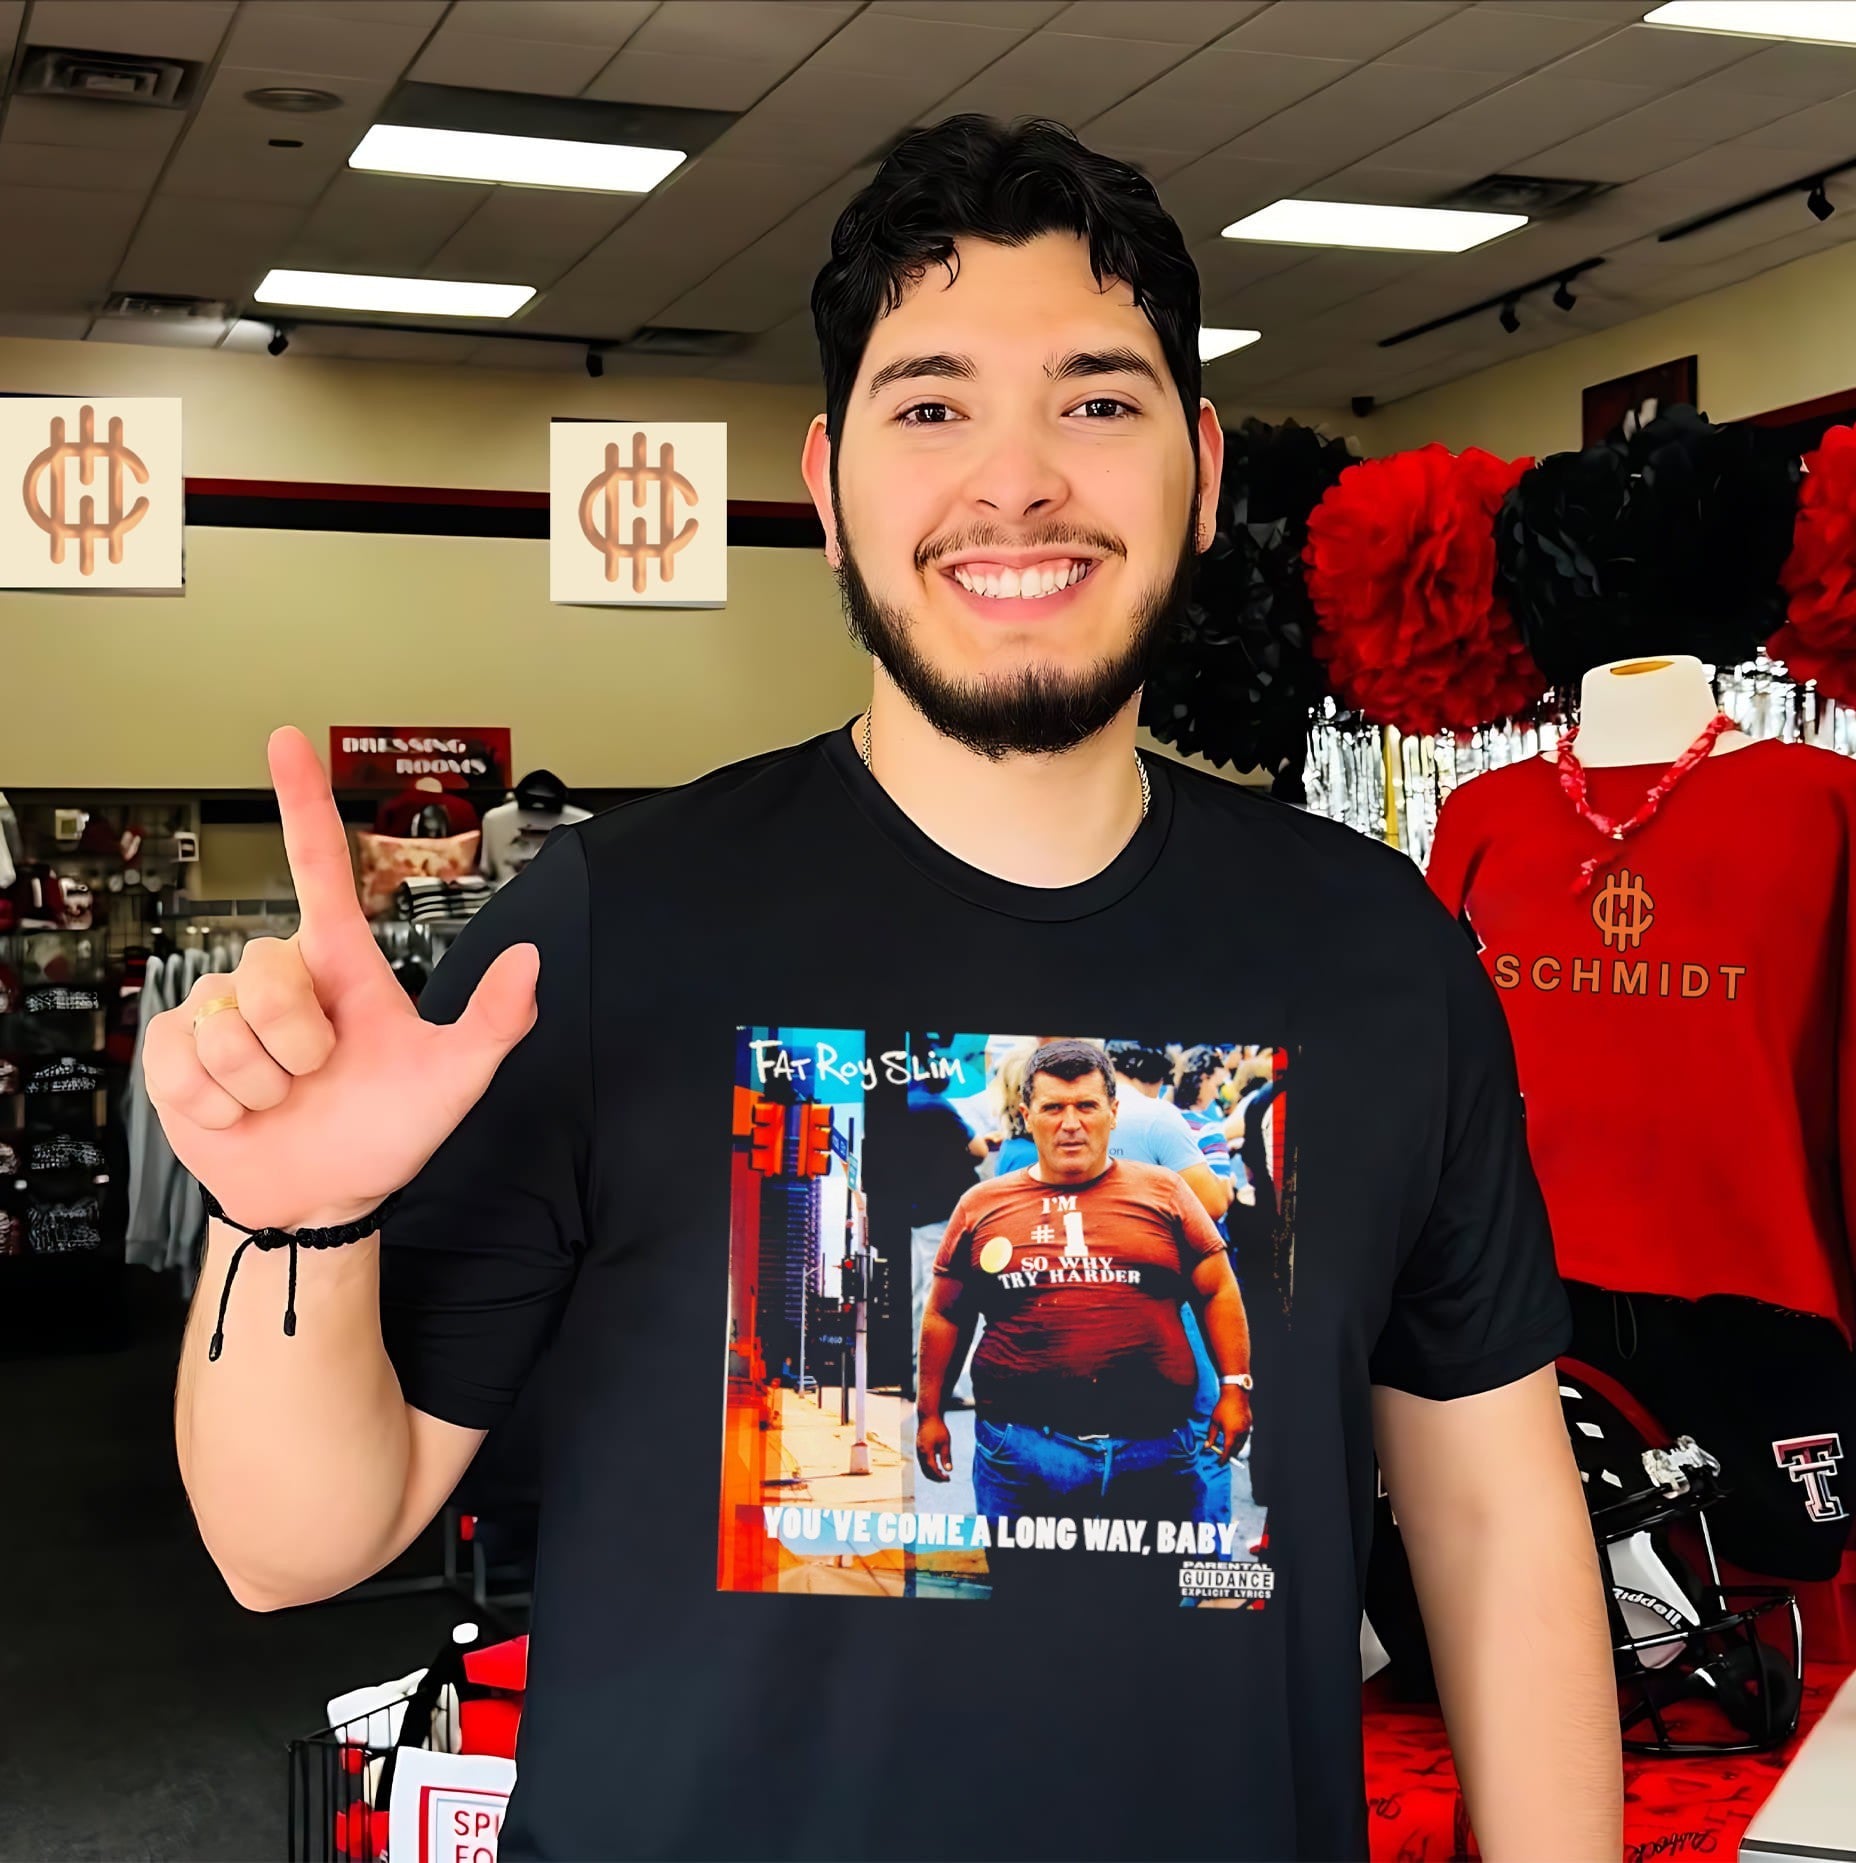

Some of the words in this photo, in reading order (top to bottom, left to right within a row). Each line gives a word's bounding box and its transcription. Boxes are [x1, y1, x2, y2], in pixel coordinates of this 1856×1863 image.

[396, 758, 487, 775] ROOMS
[1494, 953, 1746, 1000] SCHMIDT
[1041, 1195, 1078, 1214] I'M
[1020, 1256, 1049, 1273] SO
[1057, 1256, 1113, 1271] WHY
[997, 1271, 1039, 1290] TRY
[1049, 1269, 1141, 1285] HARDER
[763, 1506, 871, 1543] YOU'VE
[877, 1512, 965, 1546] COME
[970, 1515, 992, 1547] A
[997, 1515, 1078, 1551] LONG
[1083, 1518, 1151, 1556] WAY,
[1157, 1520, 1240, 1556] BABY
[1182, 1561, 1273, 1572] PARENTAL
[1183, 1571, 1272, 1588] GUIDANCE
[1181, 1588, 1231, 1597] EXPLICIT
[1234, 1589, 1272, 1599] LYRICS
